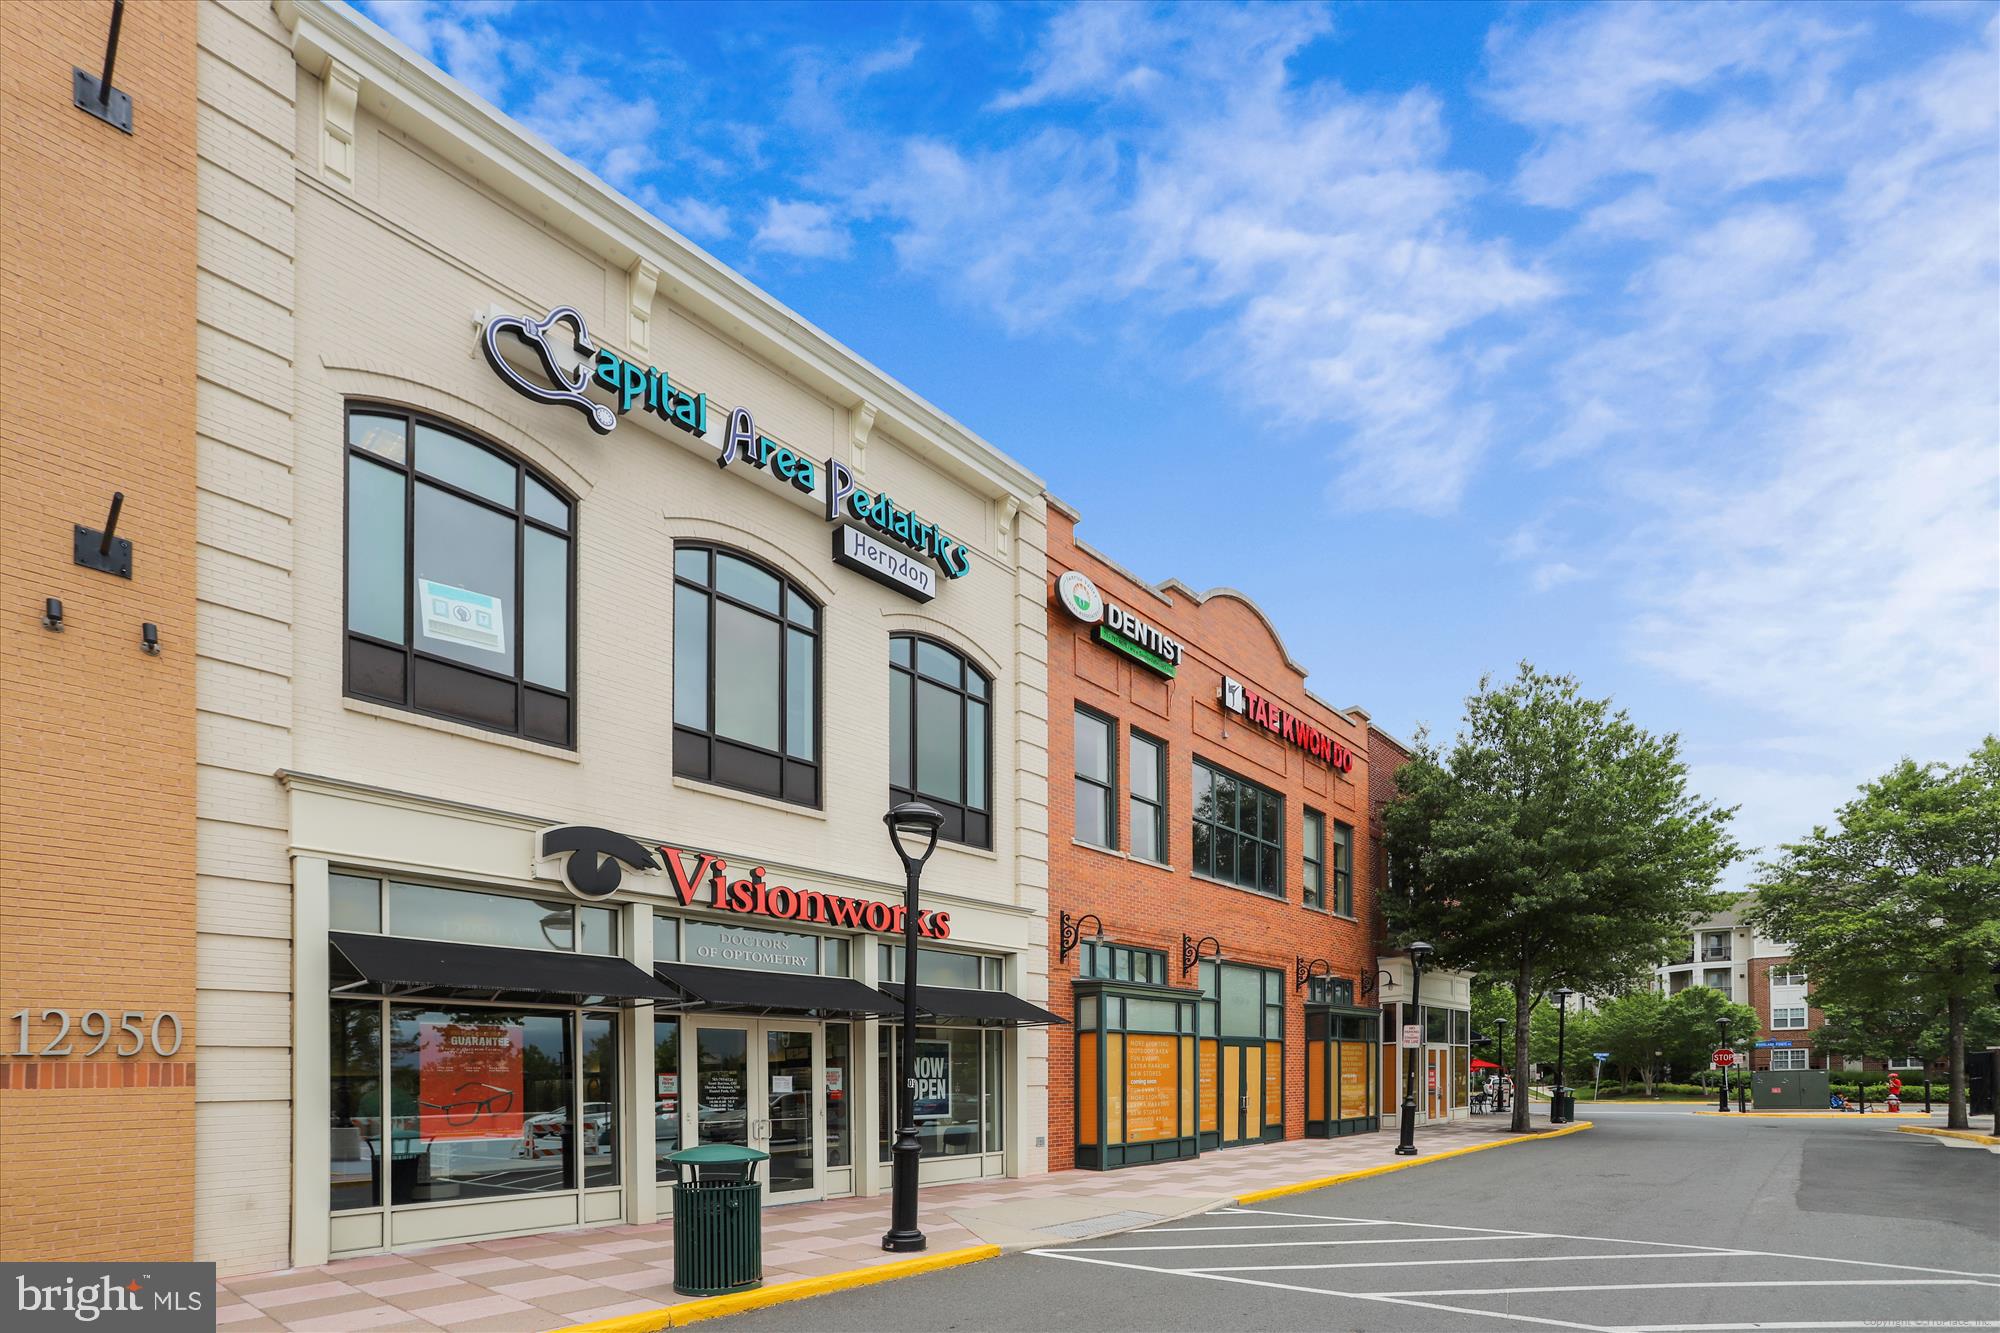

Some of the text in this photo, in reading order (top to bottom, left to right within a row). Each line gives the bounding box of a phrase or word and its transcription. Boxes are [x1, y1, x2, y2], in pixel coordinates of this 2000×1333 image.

[484, 305, 970, 579] Capital Area Pediatrics
[853, 533, 929, 590] Herndon
[1107, 602, 1185, 666] DENTIST
[1245, 688, 1353, 774] TAE KWON DO
[656, 845, 951, 940] Visionworks
[697, 945, 809, 967] OF OPTOMETRY
[719, 932, 790, 951] DOCTORS
[10, 1008, 183, 1058] 12950
[450, 1036, 511, 1047] GUARANTEE
[1713, 1054, 1734, 1062] STOP
[914, 1057, 945, 1078] NOW
